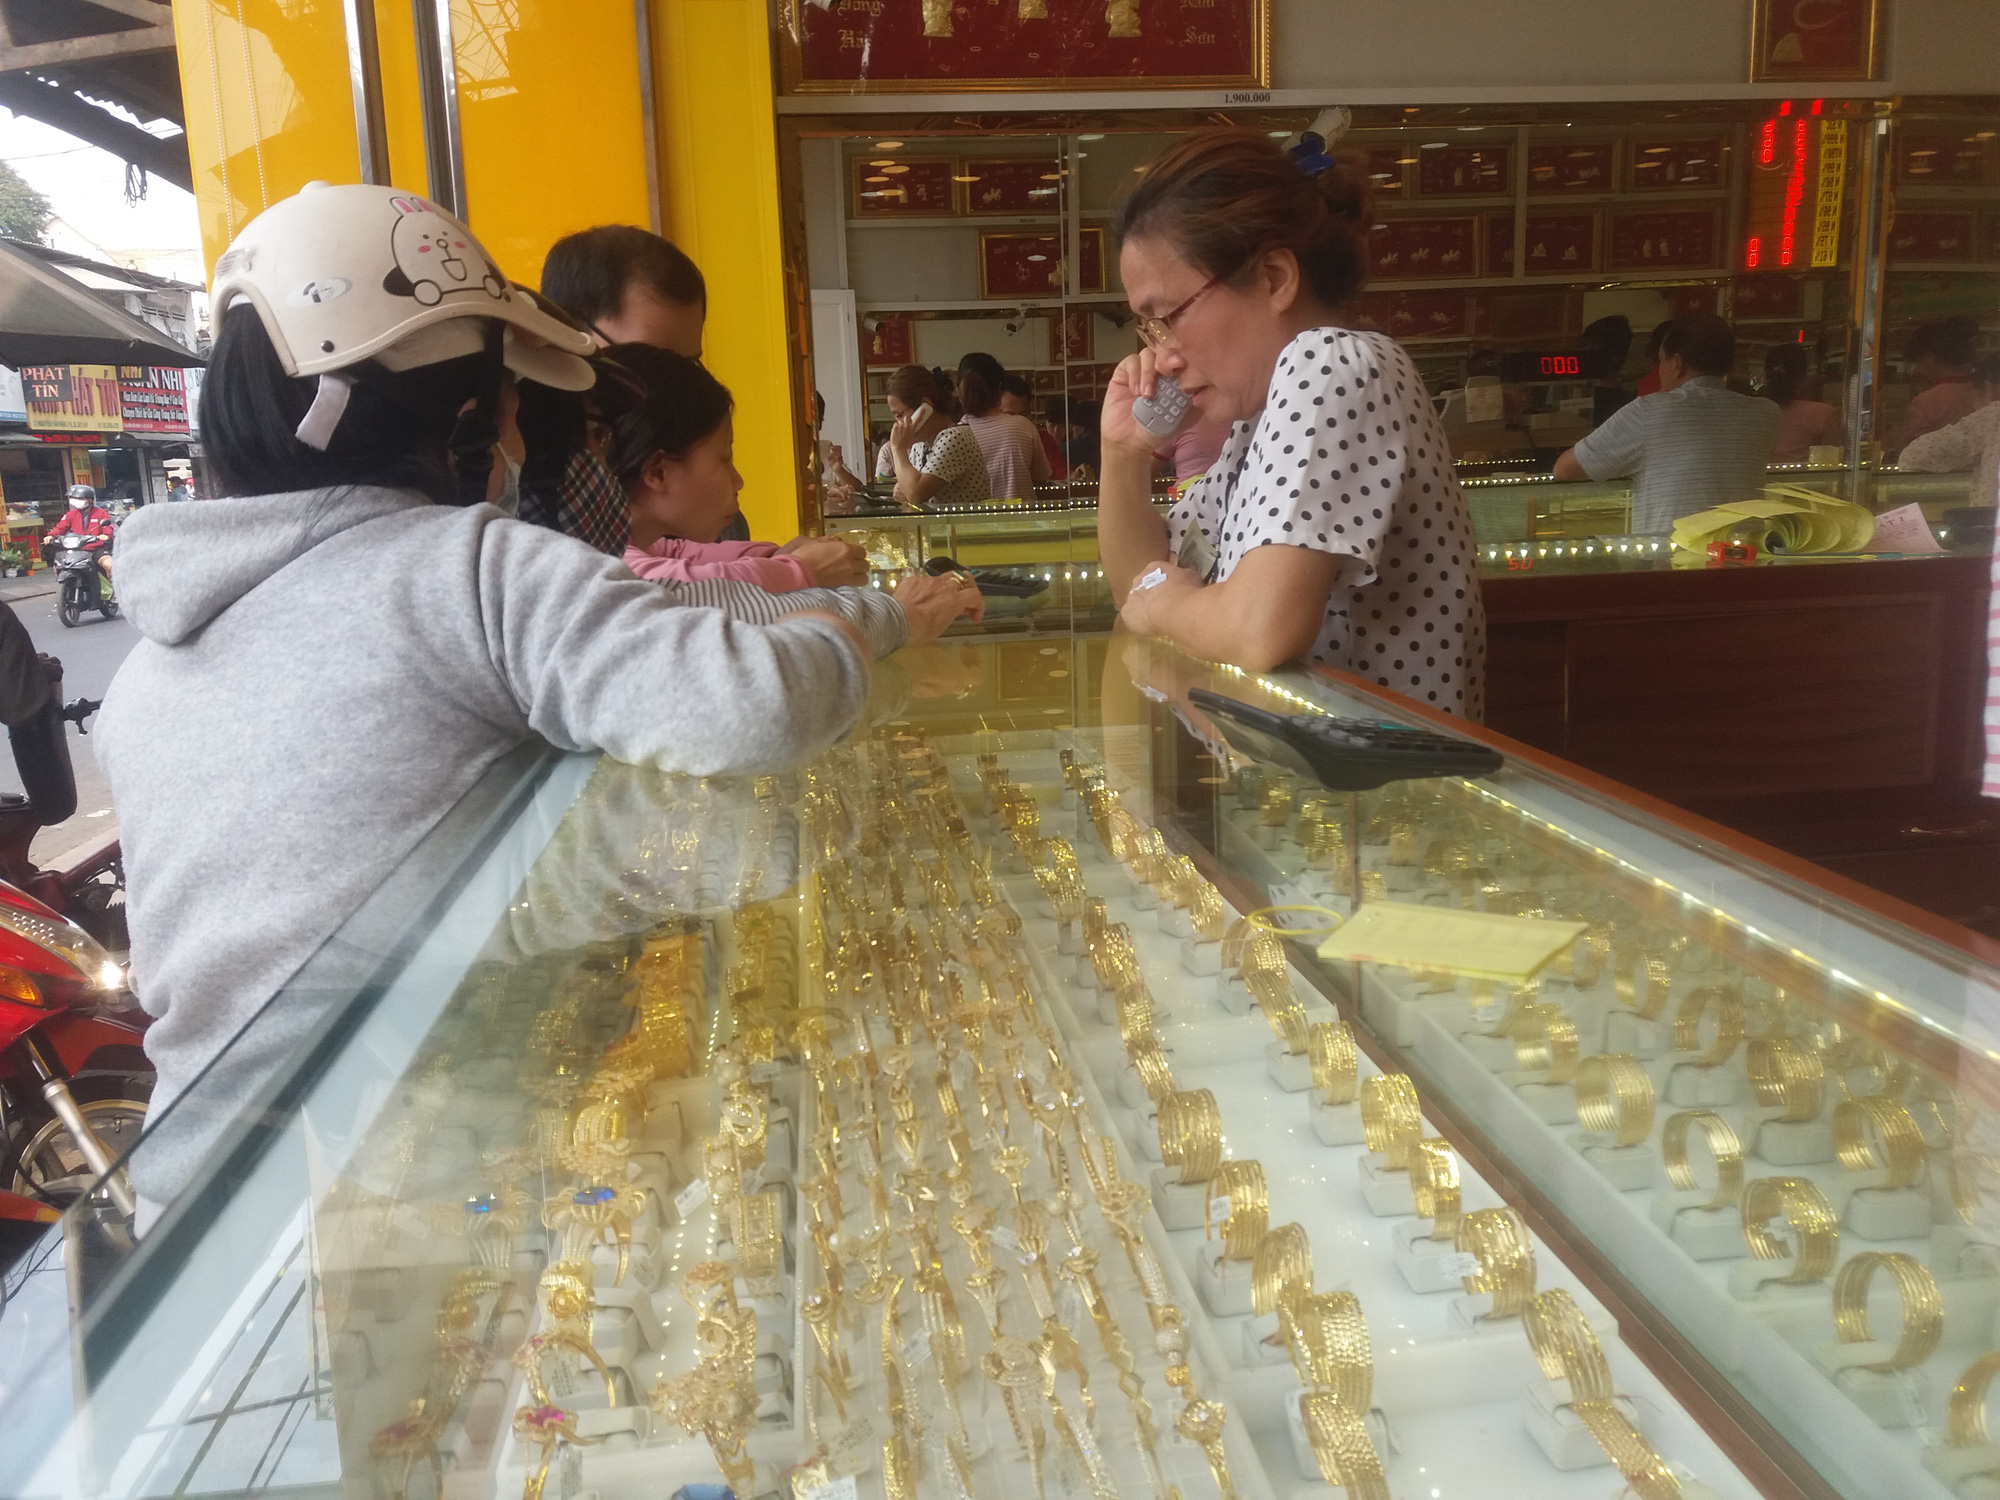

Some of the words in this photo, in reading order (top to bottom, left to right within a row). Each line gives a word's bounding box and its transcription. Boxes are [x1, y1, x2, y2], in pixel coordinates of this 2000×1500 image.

[1225, 92, 1271, 103] 1.900.000
[21, 365, 65, 381] PHÁT
[161, 369, 183, 391] NHI
[31, 381, 59, 398] TÍN
